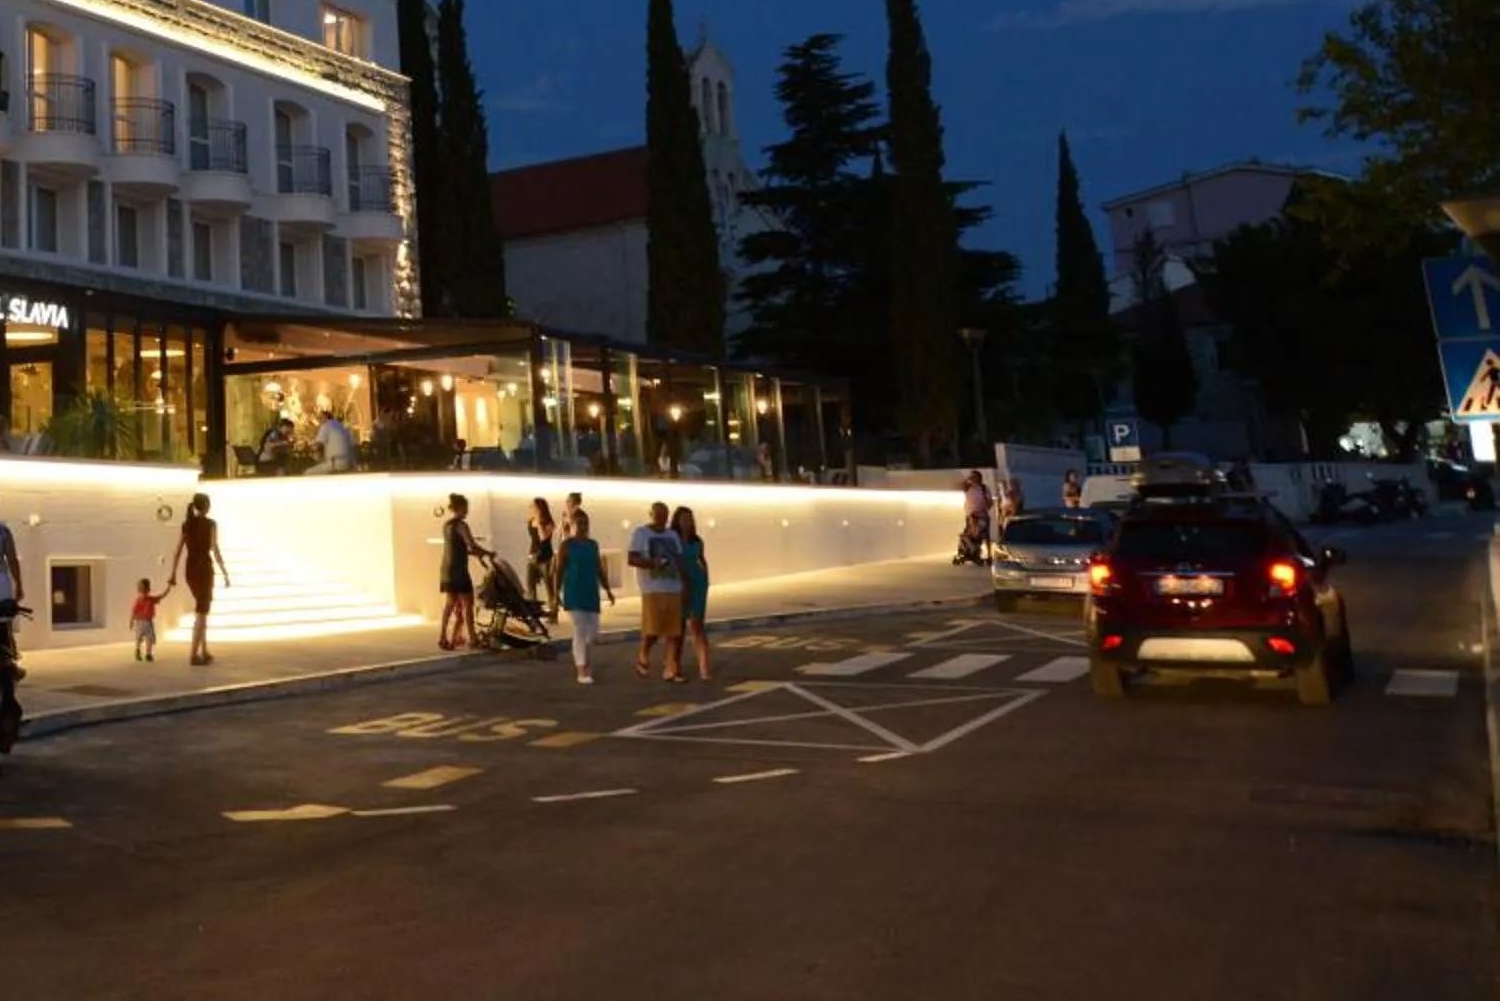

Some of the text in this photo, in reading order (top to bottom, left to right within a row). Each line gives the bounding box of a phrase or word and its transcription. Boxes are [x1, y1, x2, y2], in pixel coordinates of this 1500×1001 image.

[8, 298, 69, 329] SLAVIA
[1113, 424, 1131, 445] P
[324, 712, 560, 742] BUS
